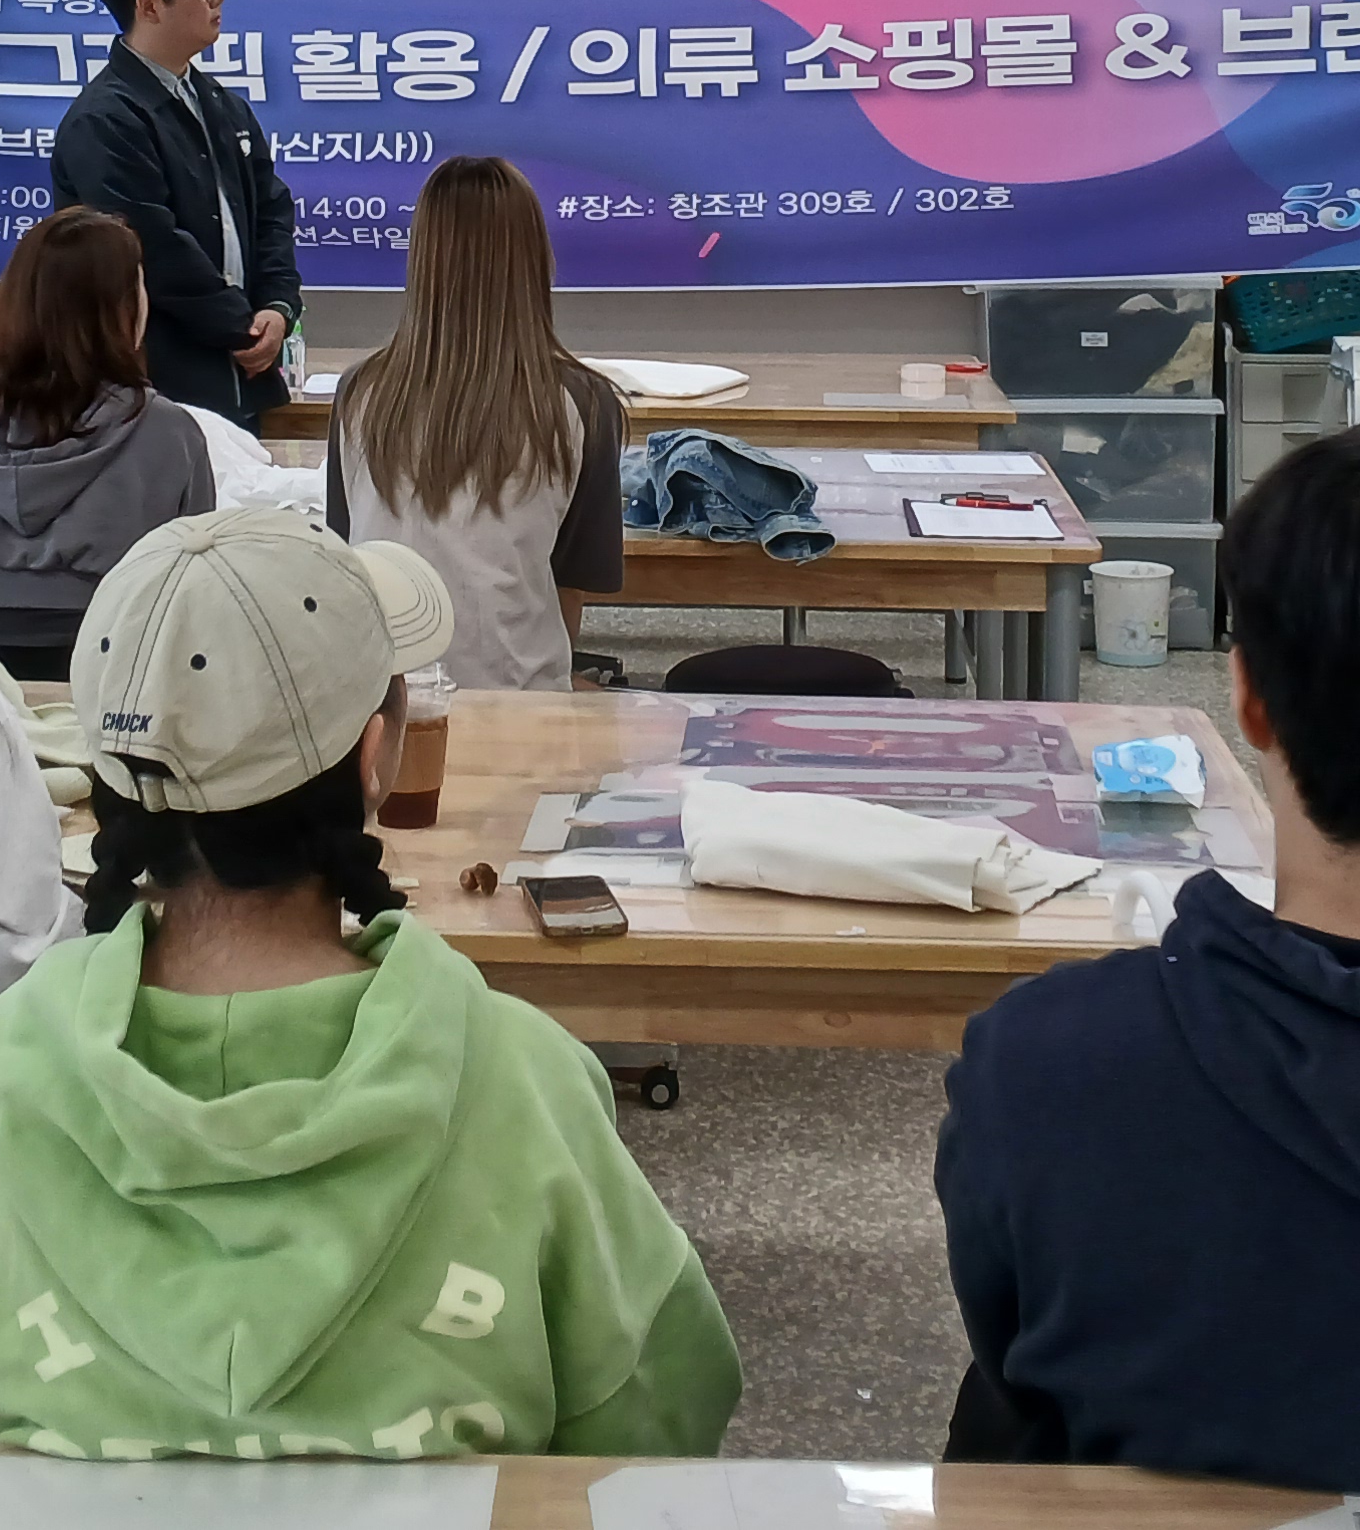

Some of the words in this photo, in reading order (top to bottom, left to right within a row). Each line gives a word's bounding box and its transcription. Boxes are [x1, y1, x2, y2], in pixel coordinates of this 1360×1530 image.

[291, 30, 479, 101] 활용
[500, 26, 550, 102] /
[567, 26, 759, 98] 의류
[784, 13, 1078, 92] 쇼핑몰
[1104, 11, 1192, 79] &
[270, 131, 435, 162] 산지사))
[295, 196, 386, 220] 14:00
[556, 194, 655, 220] #장소:
[668, 192, 767, 218] 창조관
[778, 189, 876, 215] 309호
[888, 187, 903, 216] /
[915, 185, 1014, 212] 302호
[102, 712, 153, 733] CHUCK
